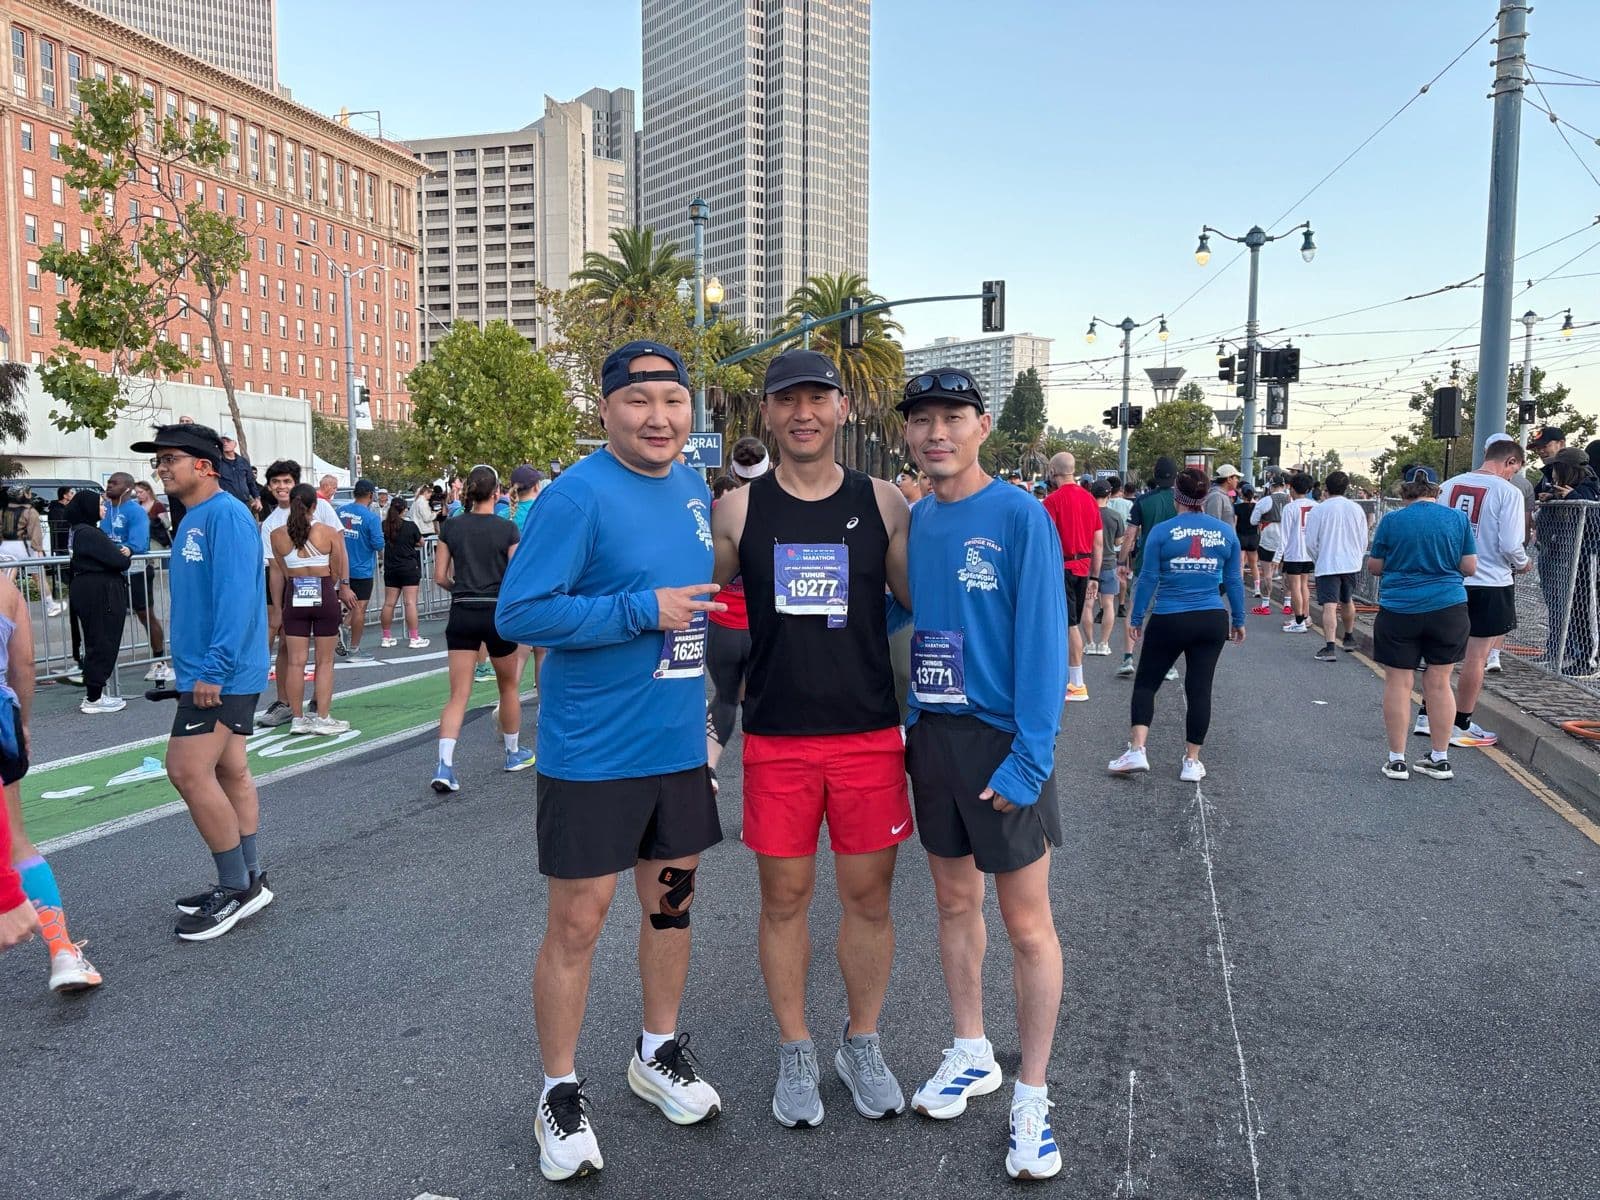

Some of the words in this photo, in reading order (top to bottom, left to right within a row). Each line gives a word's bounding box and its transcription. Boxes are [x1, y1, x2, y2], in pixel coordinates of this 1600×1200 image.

[693, 450, 701, 460] A
[787, 579, 839, 597] 19277
[673, 640, 704, 661] 16255
[916, 666, 953, 686] 13771
